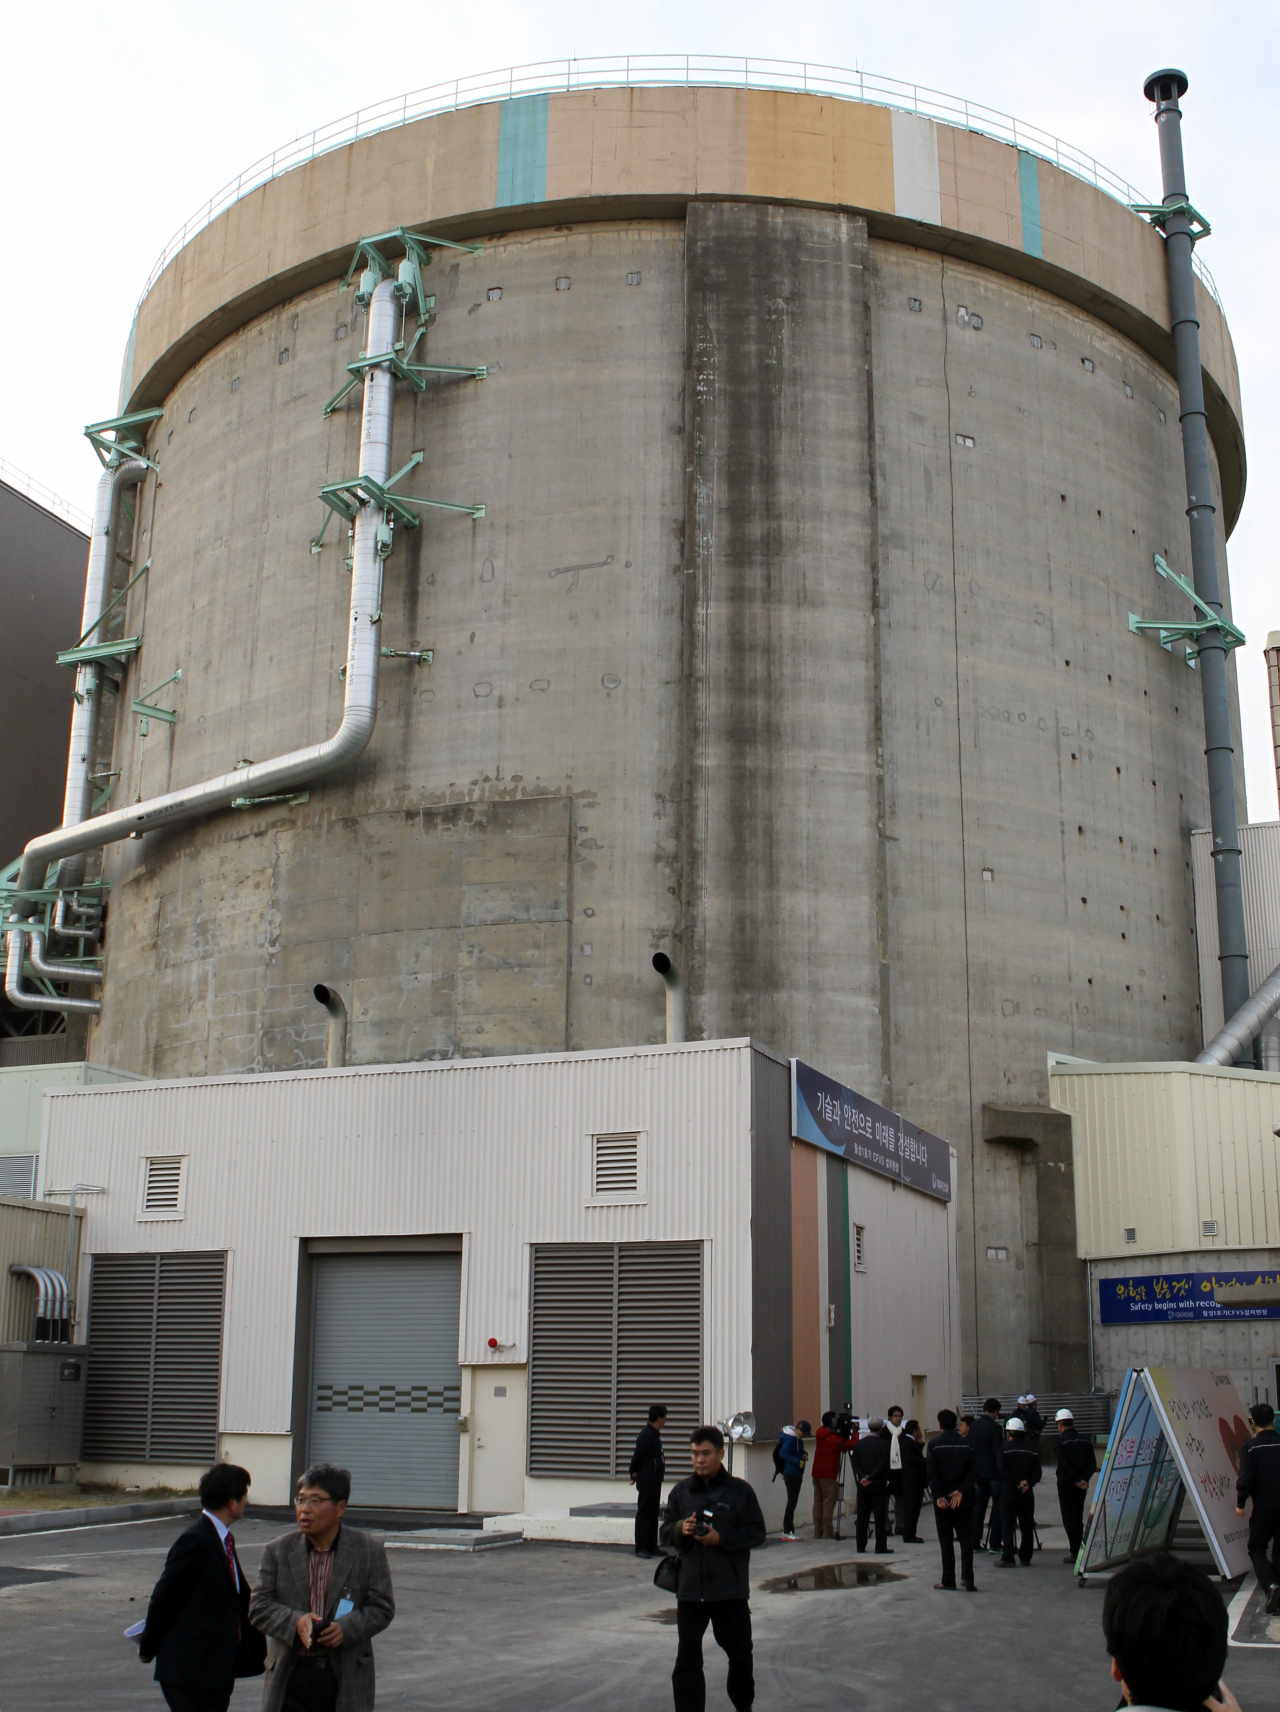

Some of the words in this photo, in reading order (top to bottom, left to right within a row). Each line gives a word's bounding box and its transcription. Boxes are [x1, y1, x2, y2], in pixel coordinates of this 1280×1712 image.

[817, 1092, 840, 1126] 기술과
[844, 1104, 872, 1139] 안전으로
[876, 1122, 895, 1152] 미래를
[898, 1132, 928, 1168] 건설합니다
[1116, 1280, 1147, 1300] 위험을
[1130, 1302, 1152, 1311] Safety
[1154, 1301, 1176, 1310] begins
[1178, 1300, 1194, 1308] with
